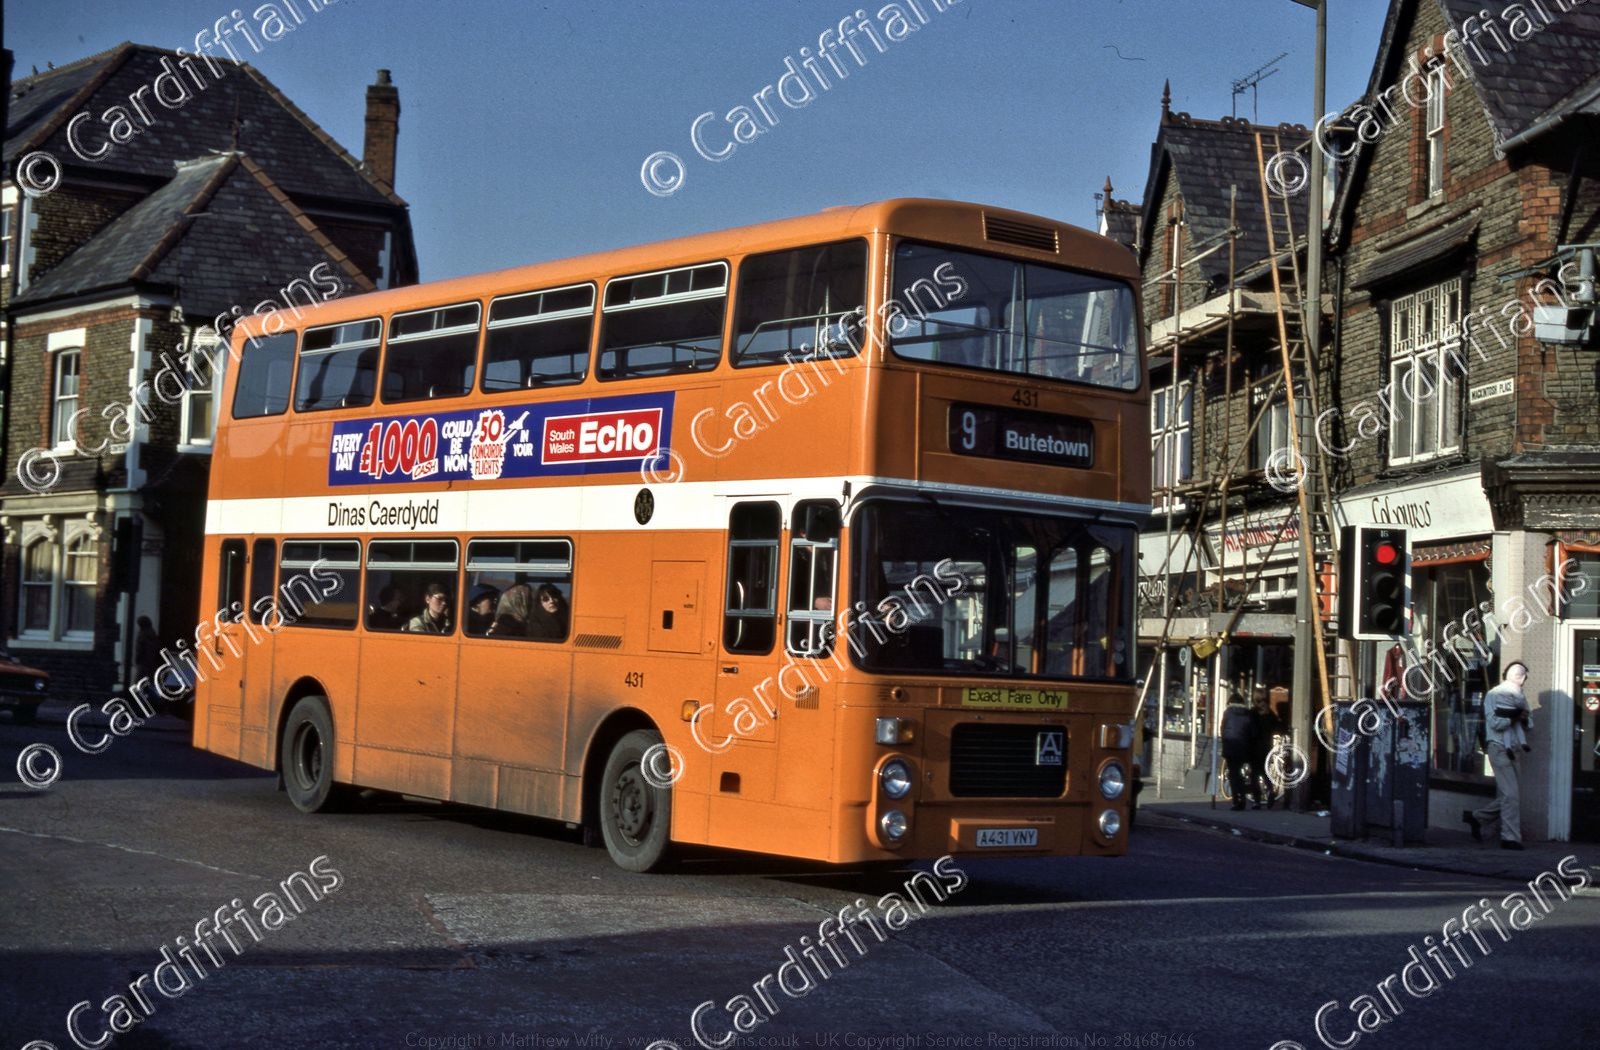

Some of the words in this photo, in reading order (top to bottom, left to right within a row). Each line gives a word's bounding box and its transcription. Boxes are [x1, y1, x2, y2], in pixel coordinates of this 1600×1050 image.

[1499, 381, 1512, 393] PLACE
[1011, 389, 1039, 408] 431
[442, 420, 473, 439] COULD
[479, 413, 503, 442] 50
[520, 429, 529, 443] IN
[549, 428, 575, 442] South
[579, 419, 653, 454] Echo
[962, 411, 977, 449] 9
[1005, 430, 1089, 457] Butetown
[332, 433, 363, 453] EVERY
[359, 417, 438, 479] £1,000
[451, 438, 464, 455] BE
[471, 443, 504, 459] CONCORDE
[513, 443, 533, 457] YOUR
[549, 442, 574, 454] Wales
[335, 452, 355, 471] DAY
[413, 460, 437, 479] CASH
[444, 454, 468, 473] WON
[474, 459, 500, 475] FLIGHTS
[328, 502, 366, 526] Dinas
[369, 499, 439, 530] Caerdydd
[624, 671, 644, 688] 431
[968, 687, 1002, 703] Exact
[1008, 689, 1032, 704] Fare
[1038, 690, 1063, 708] Only
[980, 831, 1008, 845] A431
[1012, 830, 1036, 845] VNY
